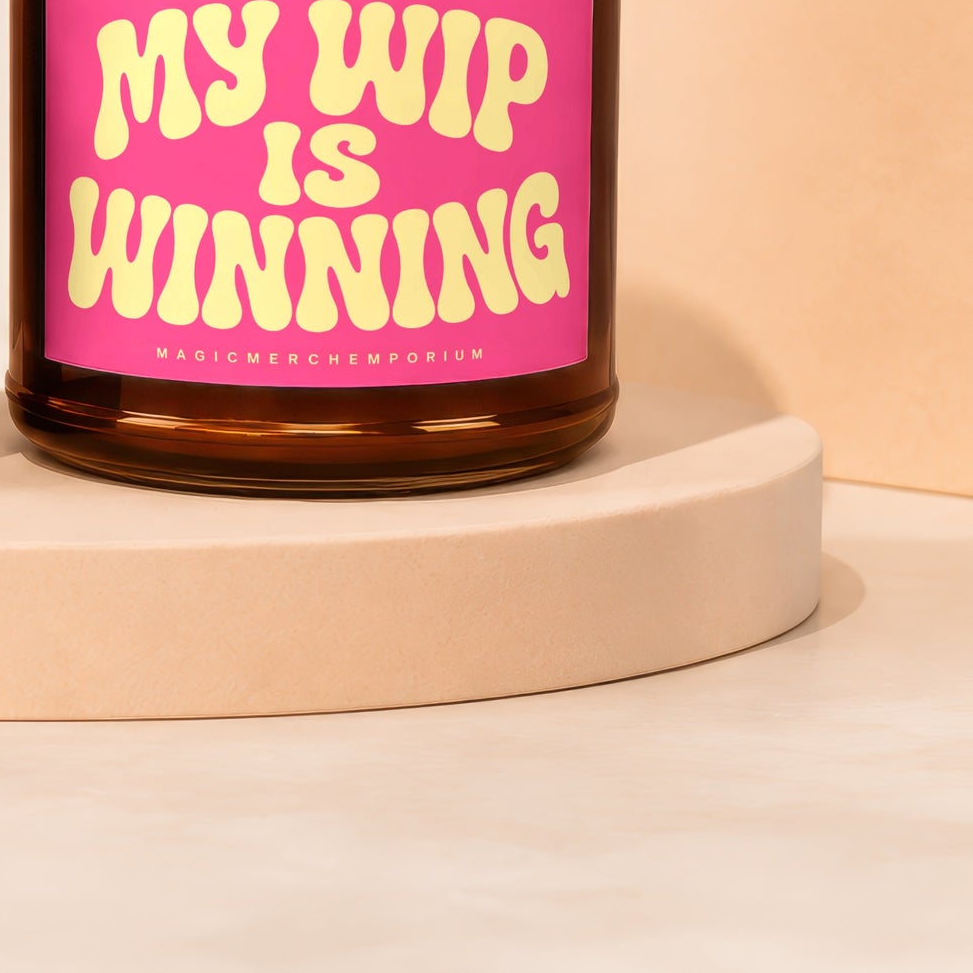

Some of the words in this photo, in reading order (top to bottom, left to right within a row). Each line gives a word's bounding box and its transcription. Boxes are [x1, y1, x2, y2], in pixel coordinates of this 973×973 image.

[94, 0, 280, 160] MY
[308, 0, 549, 153] WIP
[259, 121, 380, 208] IS
[68, 172, 570, 333] WINNING
[156, 347, 484, 365] MAGICMERCHEMPORIUM
